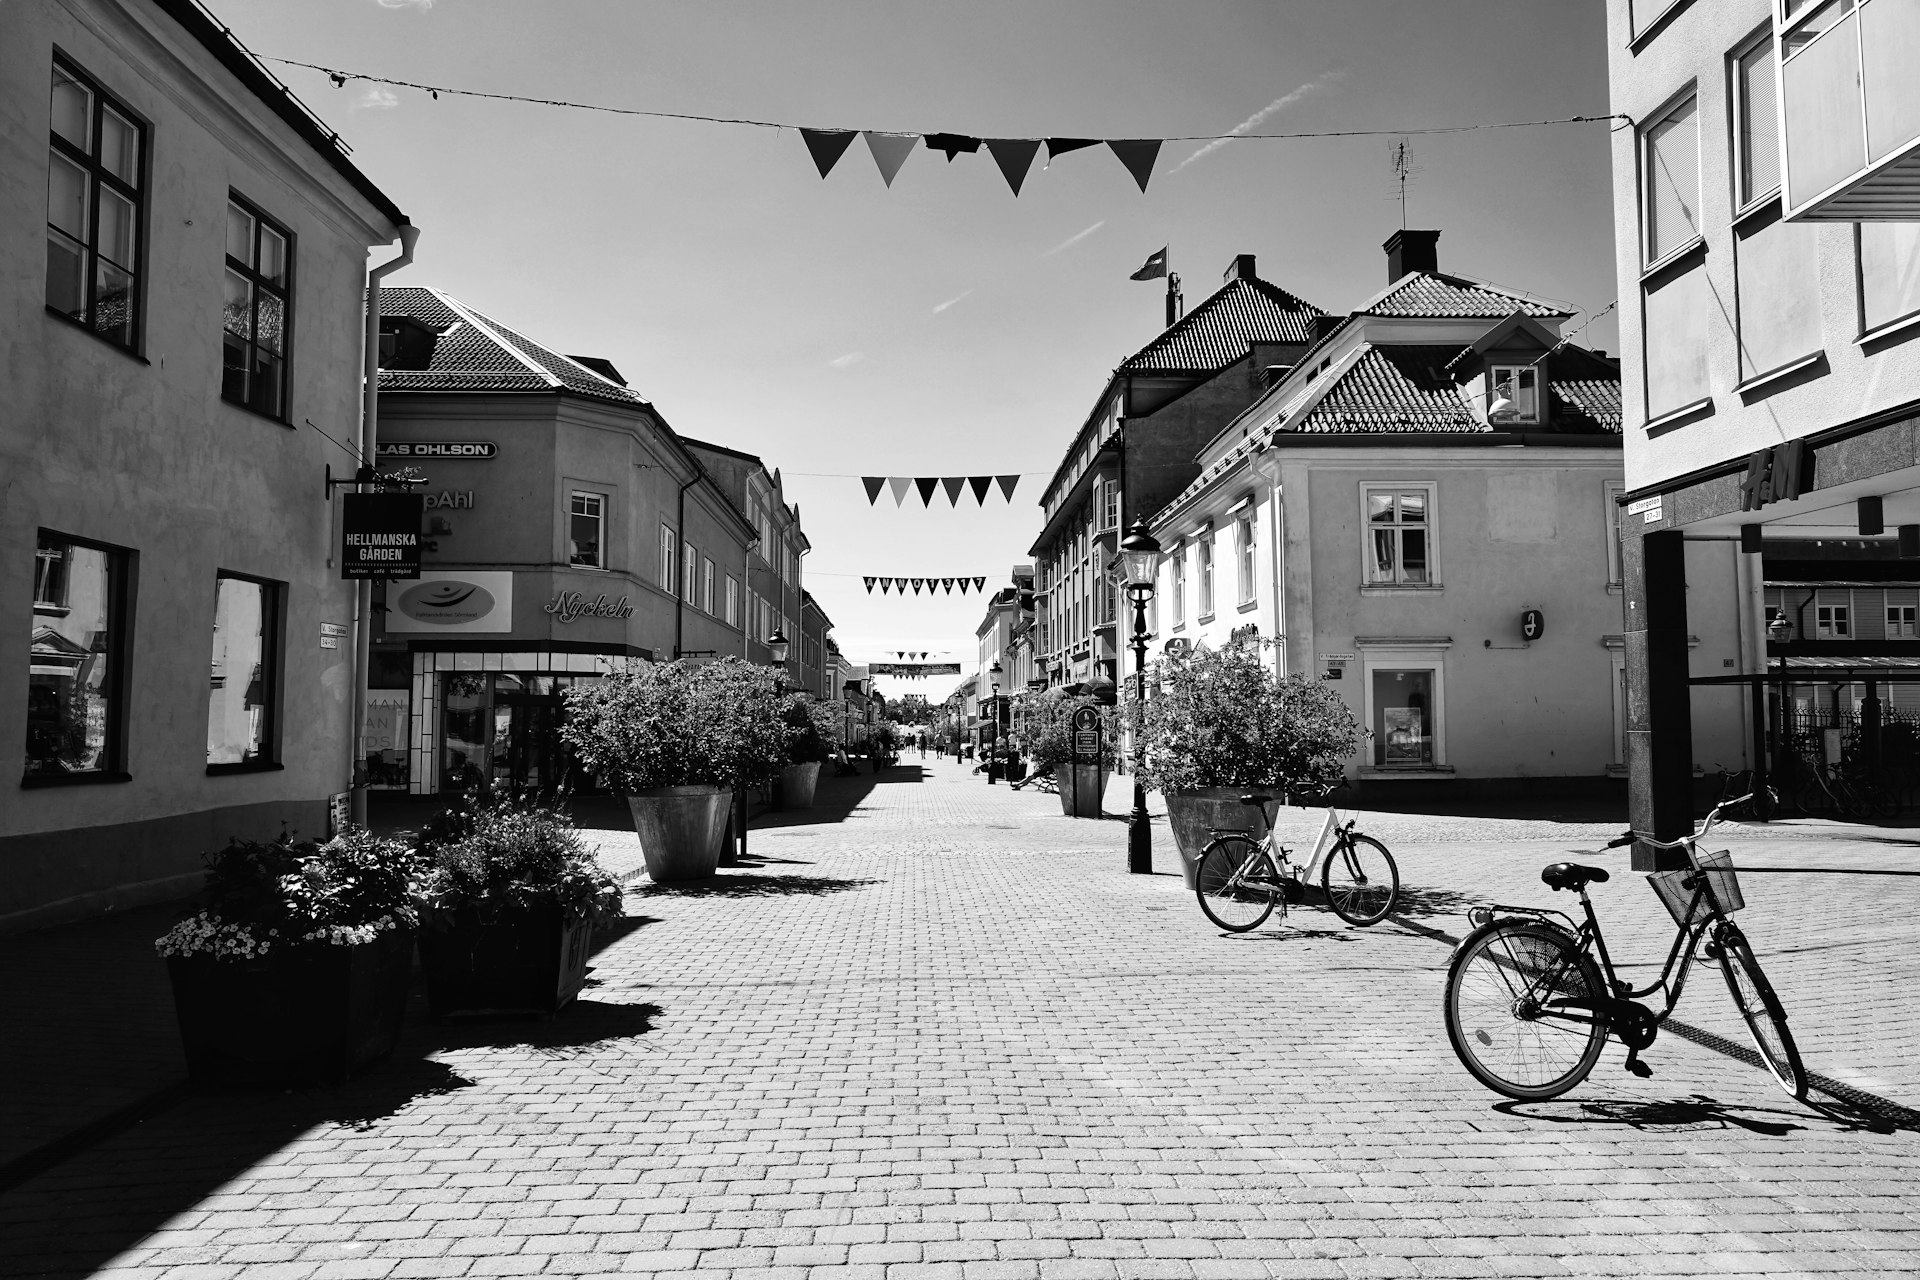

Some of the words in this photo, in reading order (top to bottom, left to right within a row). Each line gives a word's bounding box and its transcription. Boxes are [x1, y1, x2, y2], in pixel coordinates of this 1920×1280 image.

[377, 444, 410, 455] LAS
[415, 444, 489, 455] OHLSON
[1740, 437, 1804, 512] H&M
[423, 490, 474, 512] pAhl
[1635, 498, 1660, 509] Storgatan
[1645, 510, 1661, 521] 27-31
[346, 533, 417, 546] HELLMANSKA
[359, 545, 403, 561] GÅRDEN
[390, 568, 412, 576] trädgård
[544, 590, 638, 624] Nyckeln
[367, 698, 403, 711] MAN
[366, 717, 388, 729] AN
[366, 735, 391, 748] DS
